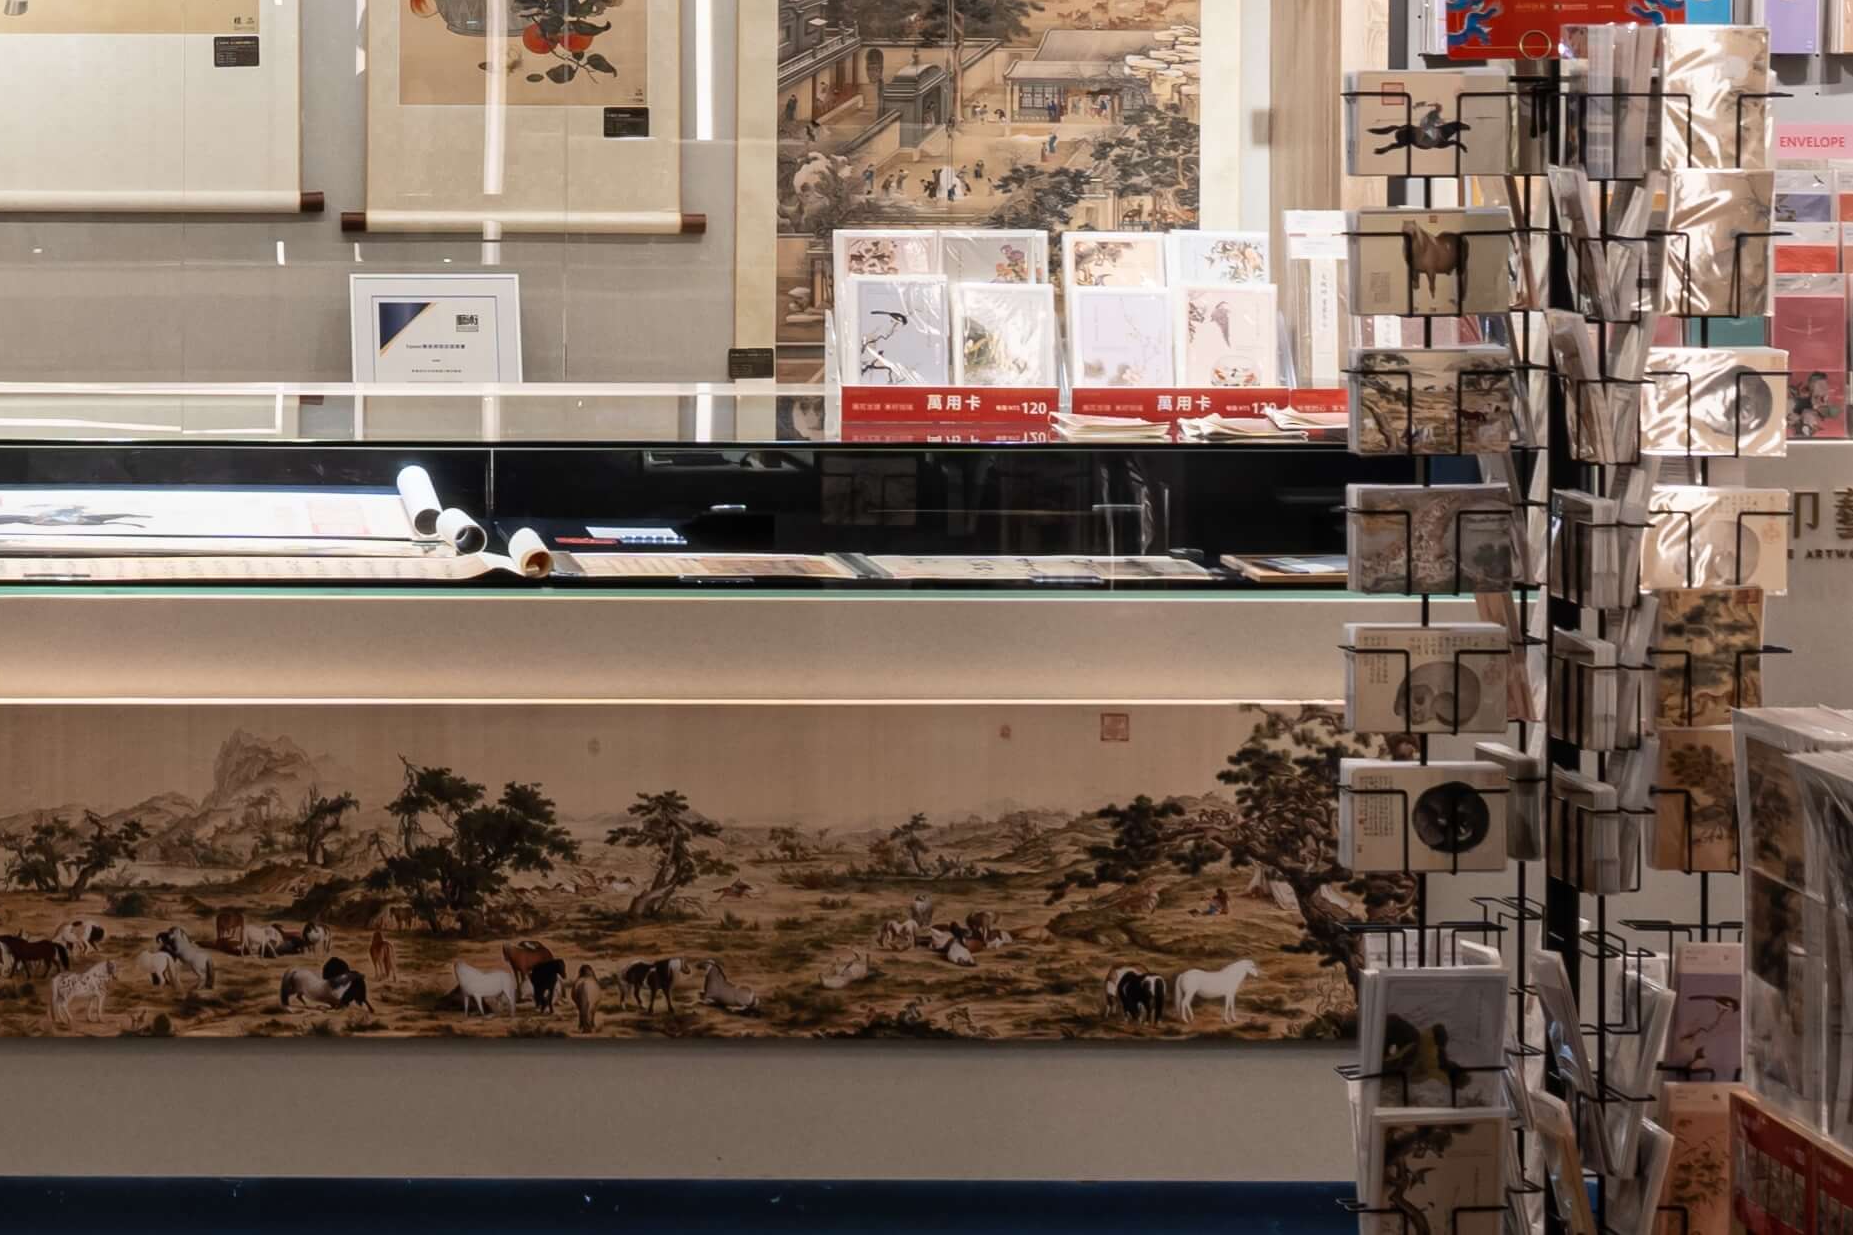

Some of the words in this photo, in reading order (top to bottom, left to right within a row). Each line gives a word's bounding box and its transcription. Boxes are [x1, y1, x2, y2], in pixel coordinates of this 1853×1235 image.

[1779, 136, 1846, 148] ENVELOPE
[926, 394, 982, 411] 萬用卡
[1020, 401, 1048, 415] 120
[1156, 395, 1213, 412] 萬用卡
